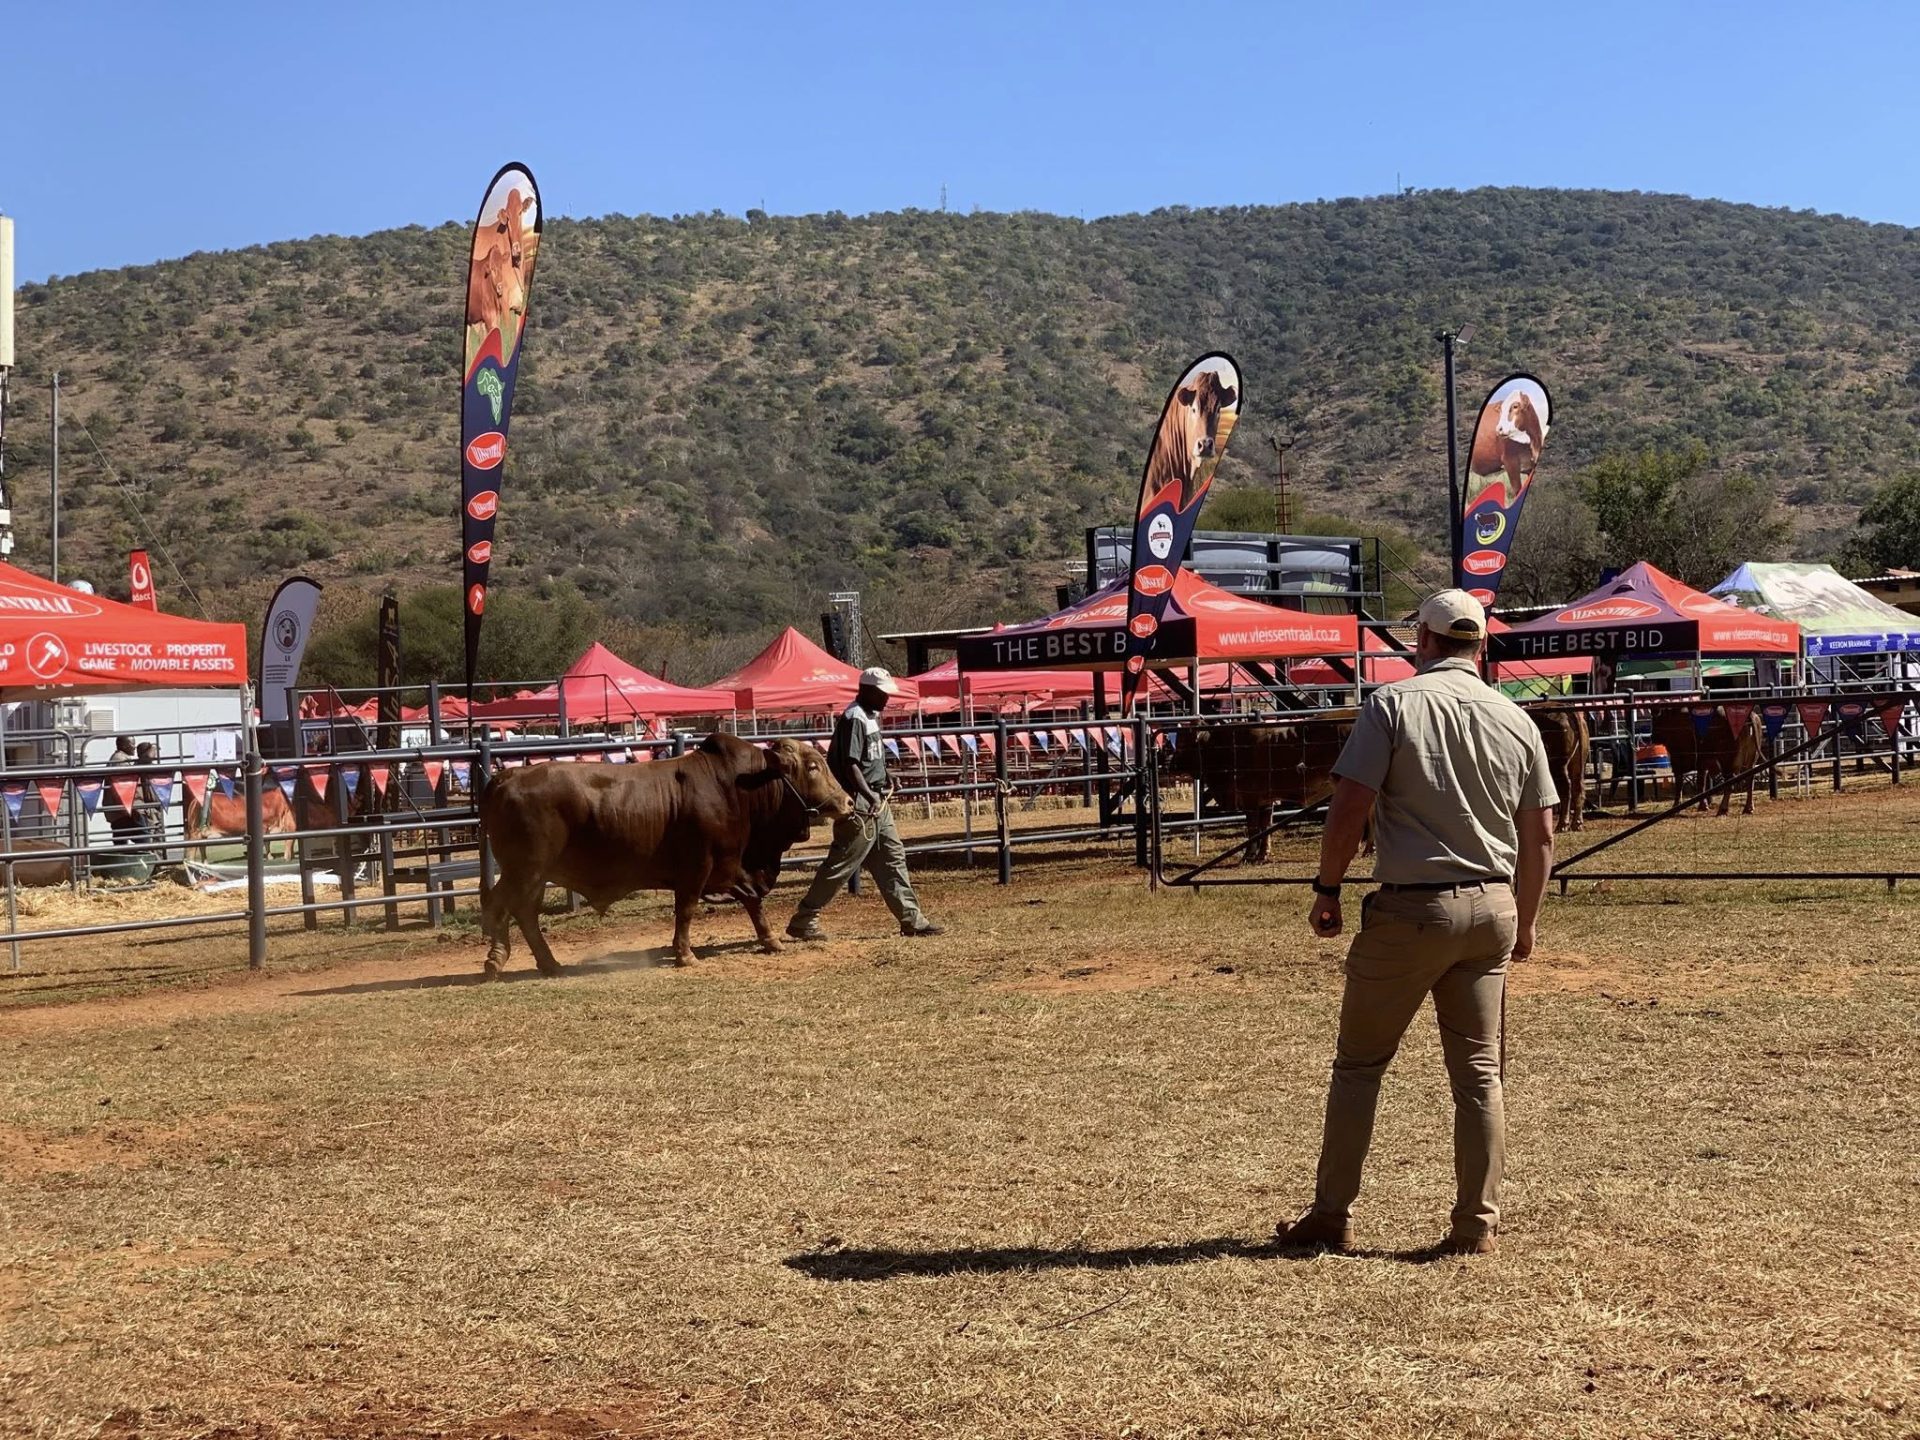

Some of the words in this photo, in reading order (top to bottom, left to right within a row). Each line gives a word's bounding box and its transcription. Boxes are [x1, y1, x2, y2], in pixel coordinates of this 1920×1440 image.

[1218, 625, 1341, 646] www.vleissentraal.co.za
[1519, 635, 1560, 655] THE
[1566, 631, 1619, 651] BEST
[1625, 629, 1664, 648] BID
[85, 643, 152, 656] LIVESTOCK
[166, 644, 226, 656] PROPERTY
[992, 637, 1040, 663] THE
[1046, 632, 1107, 657] BEST
[79, 658, 116, 670] GAME
[130, 658, 190, 671] MOVABLE
[192, 658, 235, 671] ASSETS
